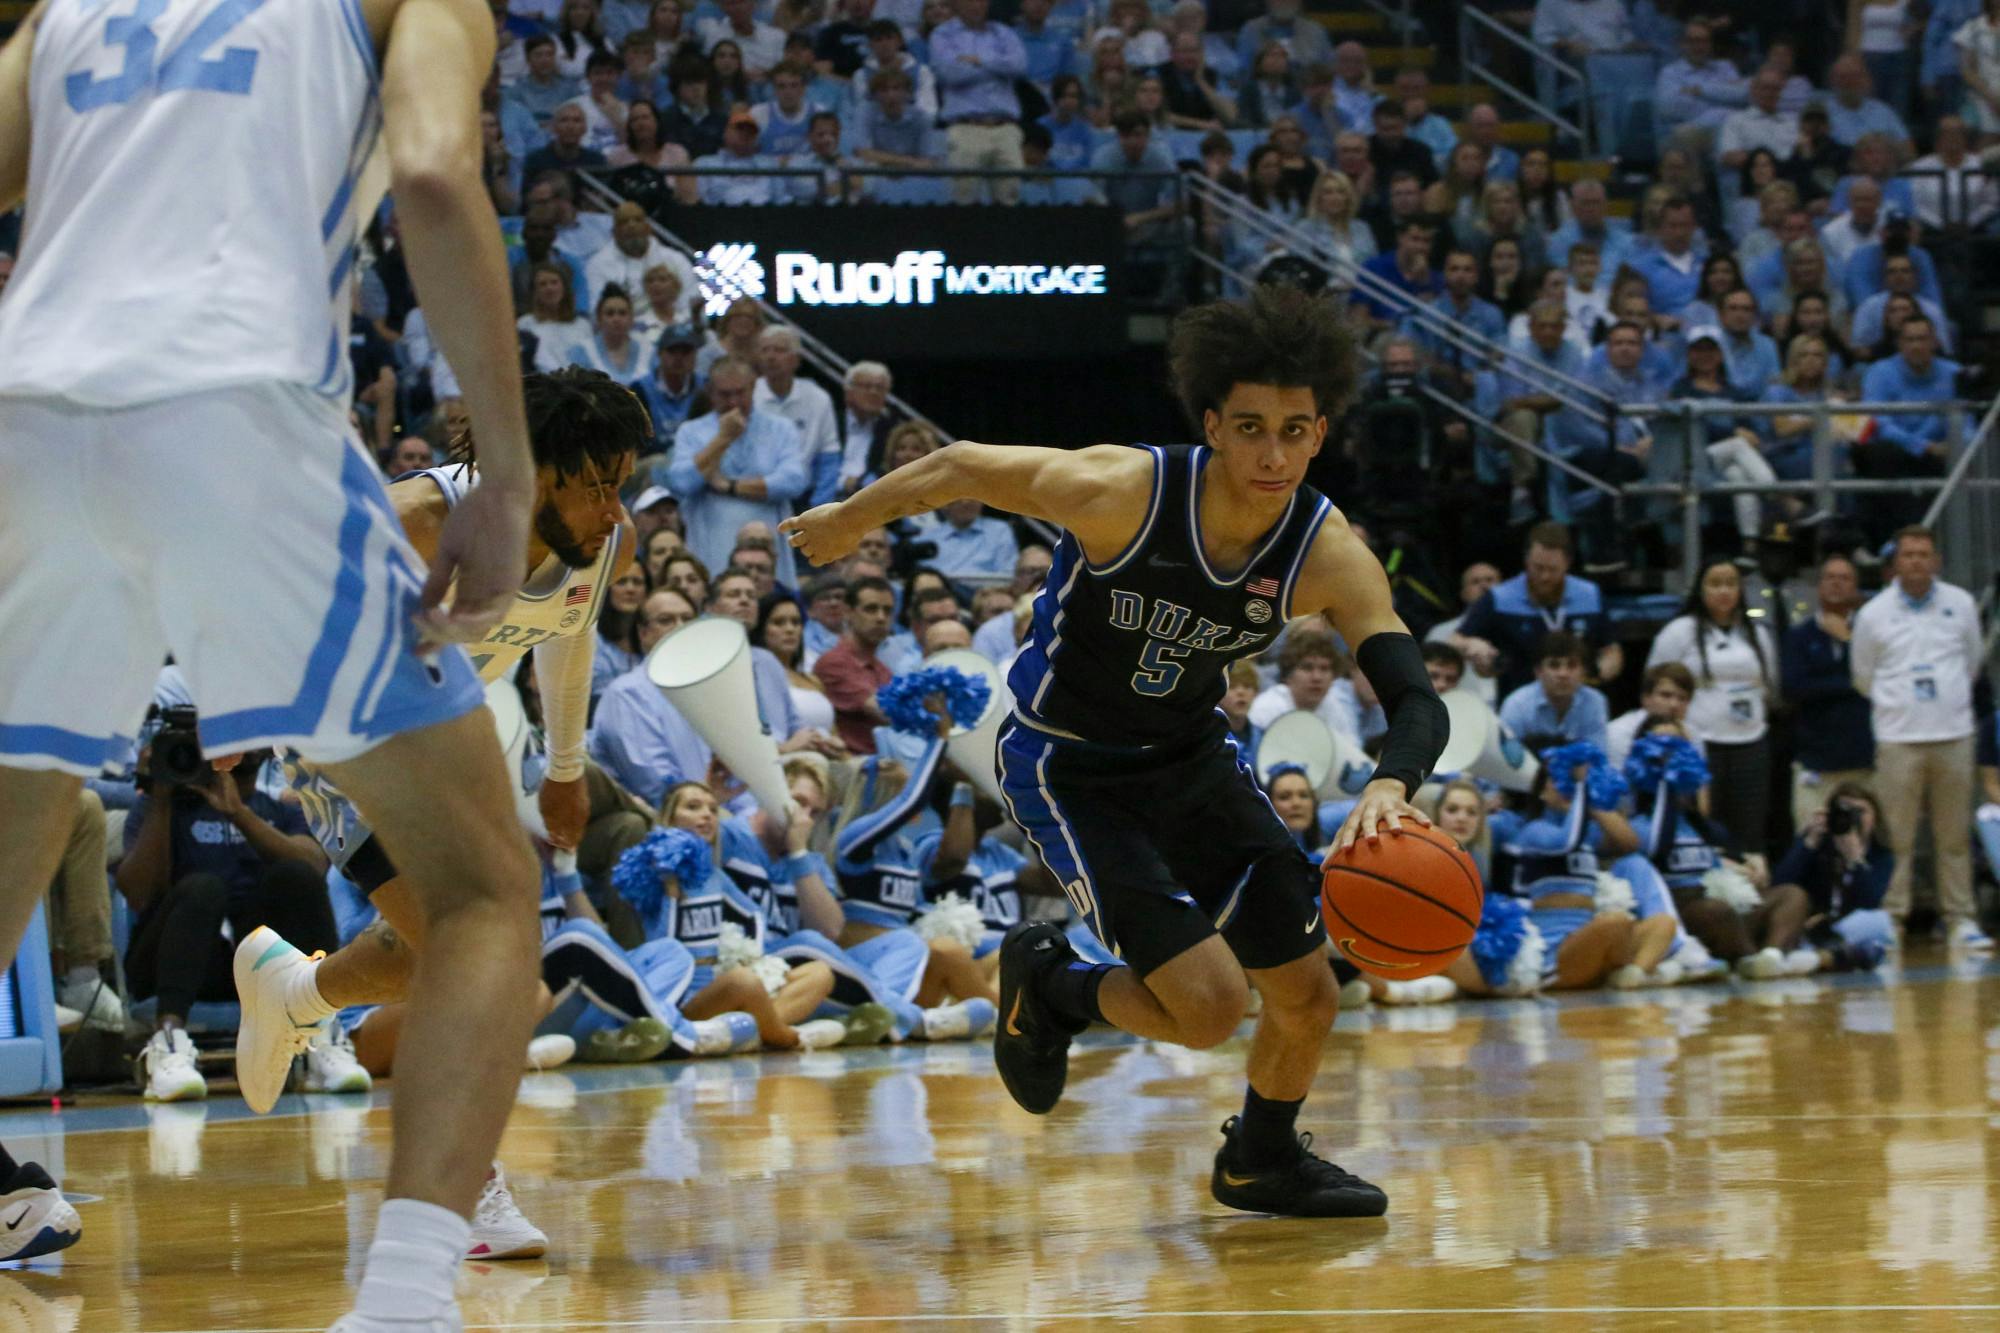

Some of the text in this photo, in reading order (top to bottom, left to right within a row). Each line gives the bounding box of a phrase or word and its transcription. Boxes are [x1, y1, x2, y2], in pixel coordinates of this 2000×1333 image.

[65, 0, 260, 114] 32
[775, 250, 1106, 305] Ruoff MORTGAGE
[1130, 638, 1192, 697] 5
